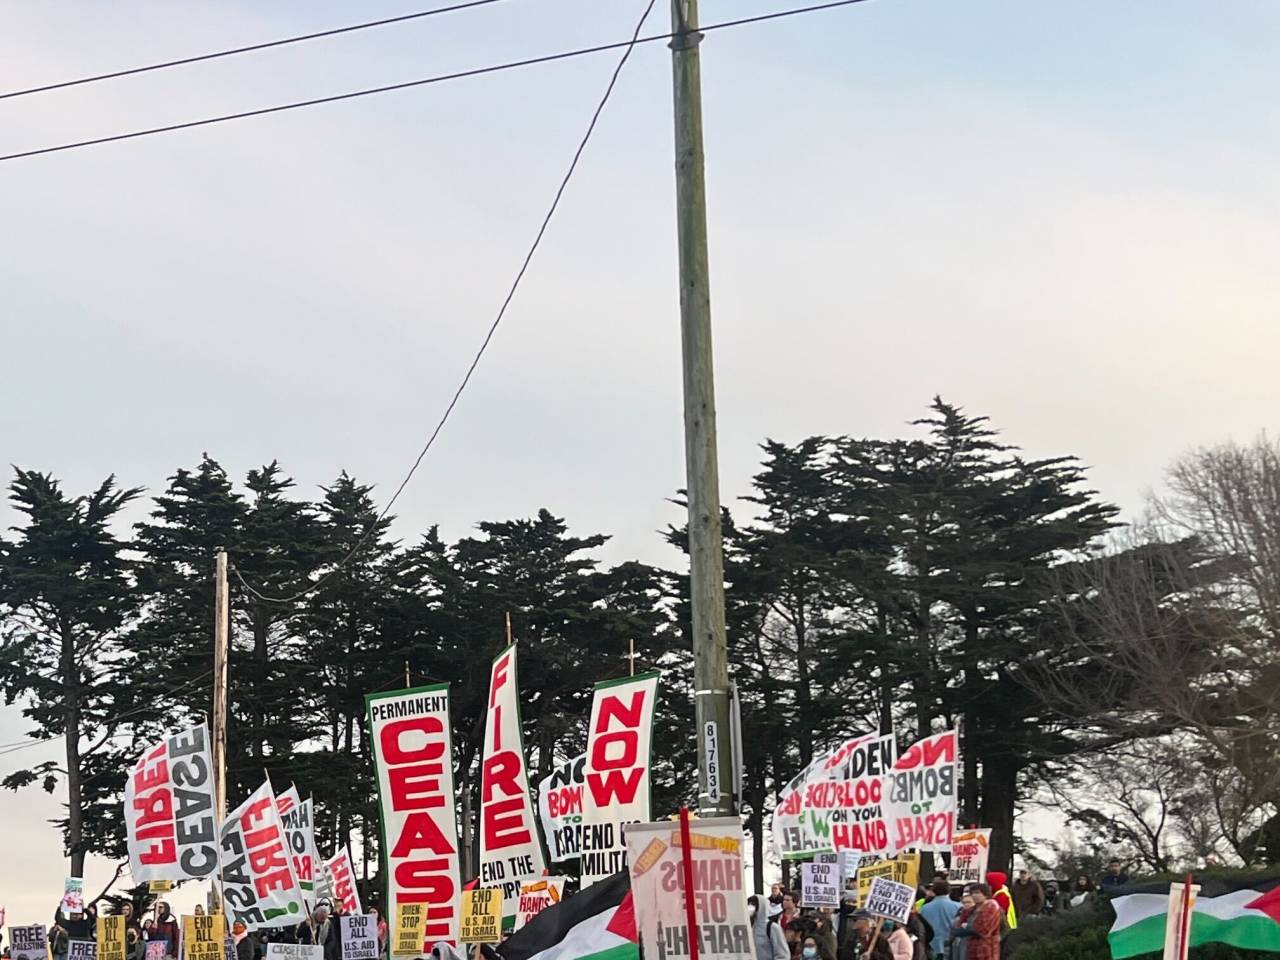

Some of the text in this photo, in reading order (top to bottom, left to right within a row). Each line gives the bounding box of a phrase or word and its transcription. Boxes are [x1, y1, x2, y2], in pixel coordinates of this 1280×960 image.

[371, 695, 448, 722] PERMANENT
[482, 654, 532, 852] FIRE
[585, 690, 646, 808] NOW
[706, 724, 718, 800] 817634
[844, 739, 893, 780] IDEN
[563, 815, 582, 824] TO
[833, 809, 847, 822] ON
[583, 822, 614, 851] END
[833, 819, 888, 853] HAND
[953, 844, 978, 856] HANDS
[581, 850, 628, 876] MILIT
[820, 854, 837, 863] END
[956, 857, 972, 868] OFF
[482, 854, 535, 883] END THE
[811, 864, 830, 874] END
[813, 875, 829, 885] ALL
[472, 890, 492, 902] END
[805, 887, 836, 896] U.S. AID
[873, 888, 910, 905] END THE
[472, 903, 489, 916] ALL
[868, 899, 906, 919] NOW!
[105, 917, 118, 929] END
[194, 916, 213, 929] END
[349, 917, 368, 928] END
[402, 916, 420, 928] STOP
[465, 917, 495, 927] U.S. AID
[12, 926, 43, 943] FREE
[105, 929, 117, 941] ALL
[196, 929, 213, 942] ALL
[351, 928, 368, 939] ALL
[462, 926, 498, 936] TO ISRAEL
[12, 941, 46, 952] PALESTINE
[191, 942, 218, 953] U.S. AID
[344, 940, 375, 951] U.S. AID
[399, 941, 417, 949] ISRAEL
[344, 950, 376, 959] TO ISRAEL!
